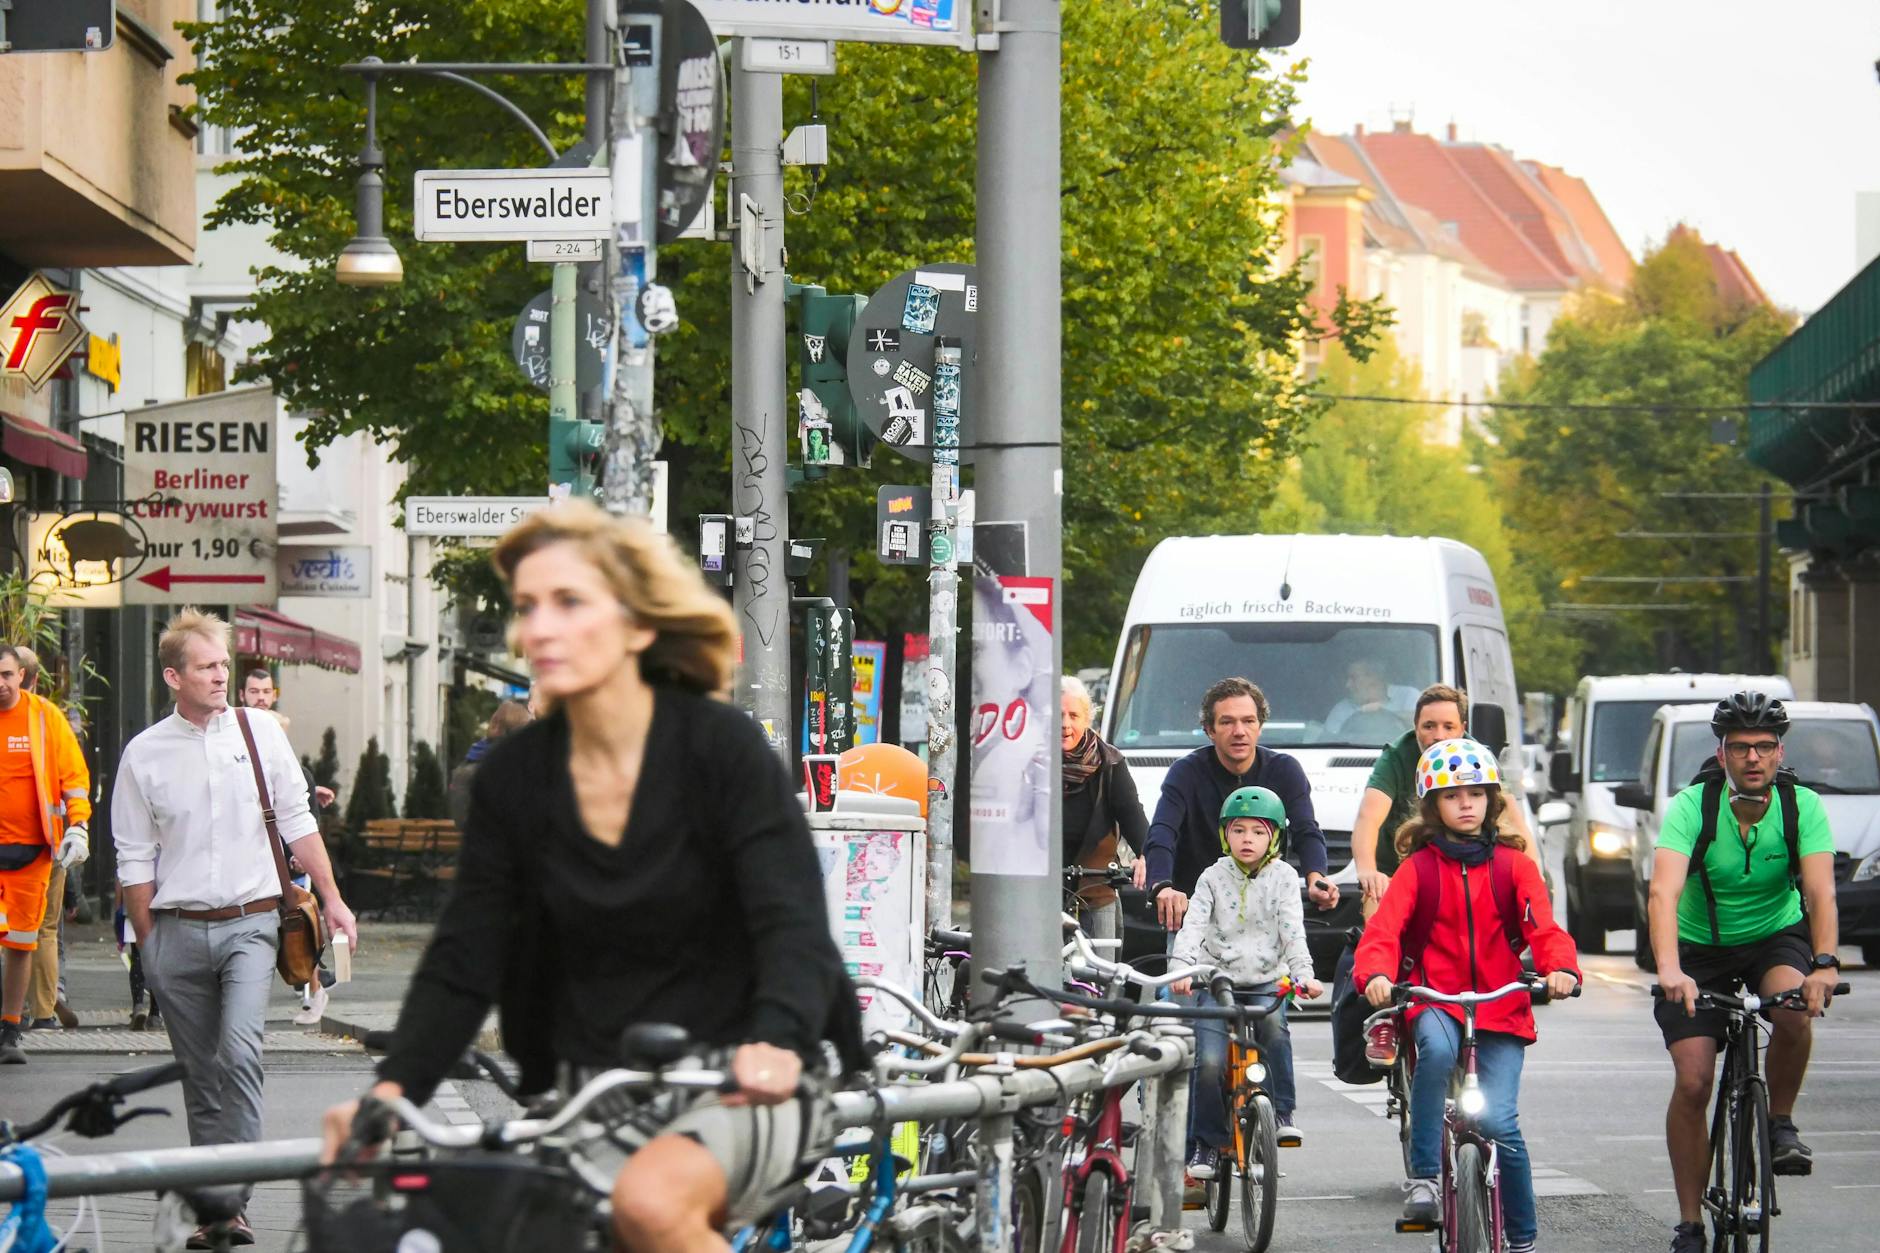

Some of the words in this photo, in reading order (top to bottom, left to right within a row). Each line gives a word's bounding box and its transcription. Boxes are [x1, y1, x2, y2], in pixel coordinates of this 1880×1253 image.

[778, 45, 801, 59] 15-1
[436, 187, 600, 219] Eberswalder
[555, 243, 580, 254] 2-24
[5, 294, 70, 368] f
[892, 372, 924, 396] GESAGT?
[896, 364, 929, 390] RAVEN
[135, 421, 268, 453] RIESEN
[154, 468, 249, 490] Berliner
[133, 497, 268, 524] Currywurst
[416, 507, 504, 524] Eberswalder
[145, 542, 183, 558] nur
[192, 538, 239, 561] 1,90
[1180, 602, 1232, 619] täglich
[1242, 600, 1294, 614] frische
[1304, 600, 1392, 618] Backwaren
[971, 697, 1028, 746] DO
